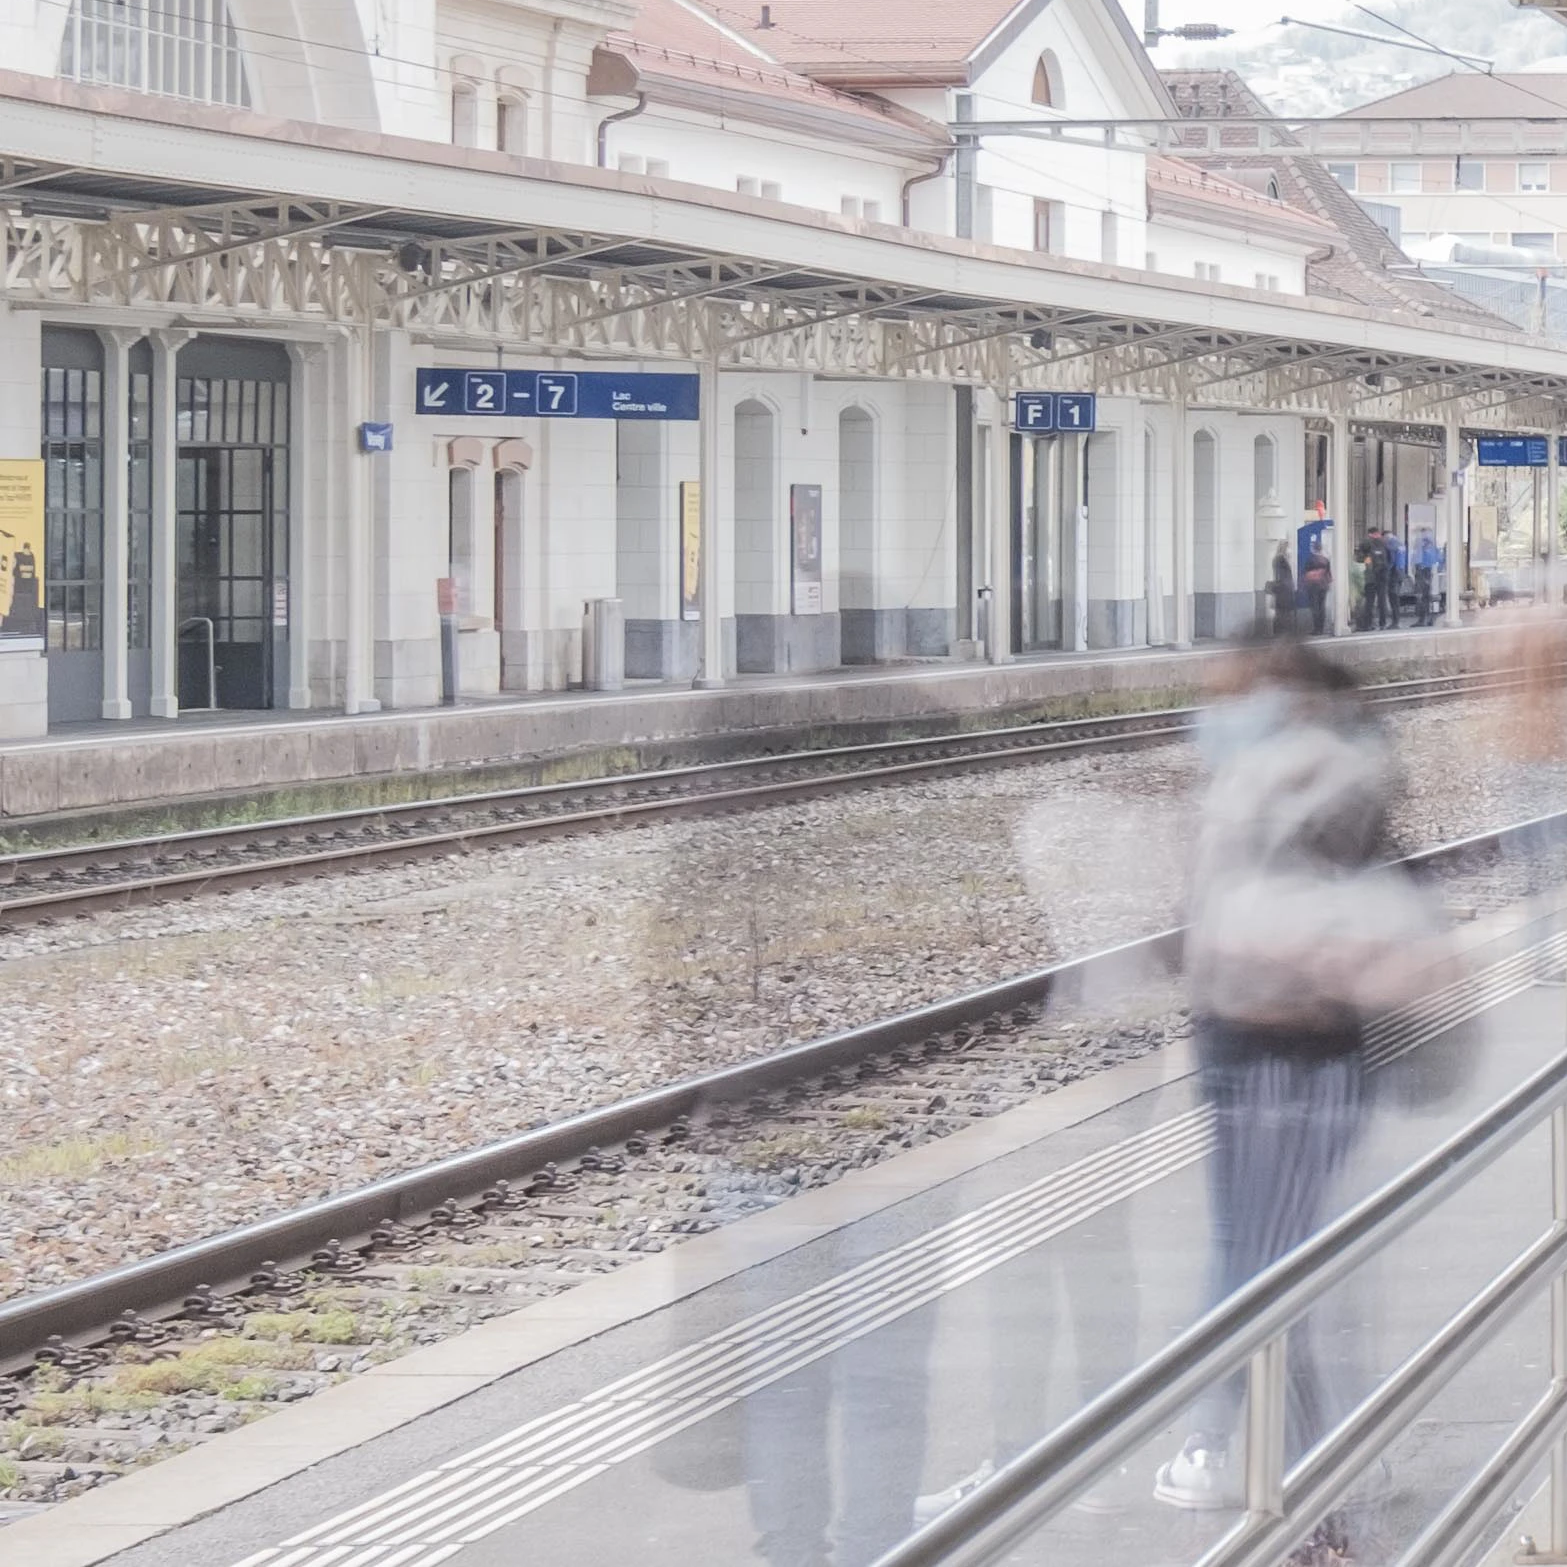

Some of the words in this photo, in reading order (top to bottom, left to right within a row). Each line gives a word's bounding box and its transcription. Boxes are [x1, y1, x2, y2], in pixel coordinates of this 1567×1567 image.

[476, 384, 494, 408] 2
[548, 385, 565, 410] 7
[1028, 404, 1043, 425] F
[1069, 405, 1080, 425] 1
